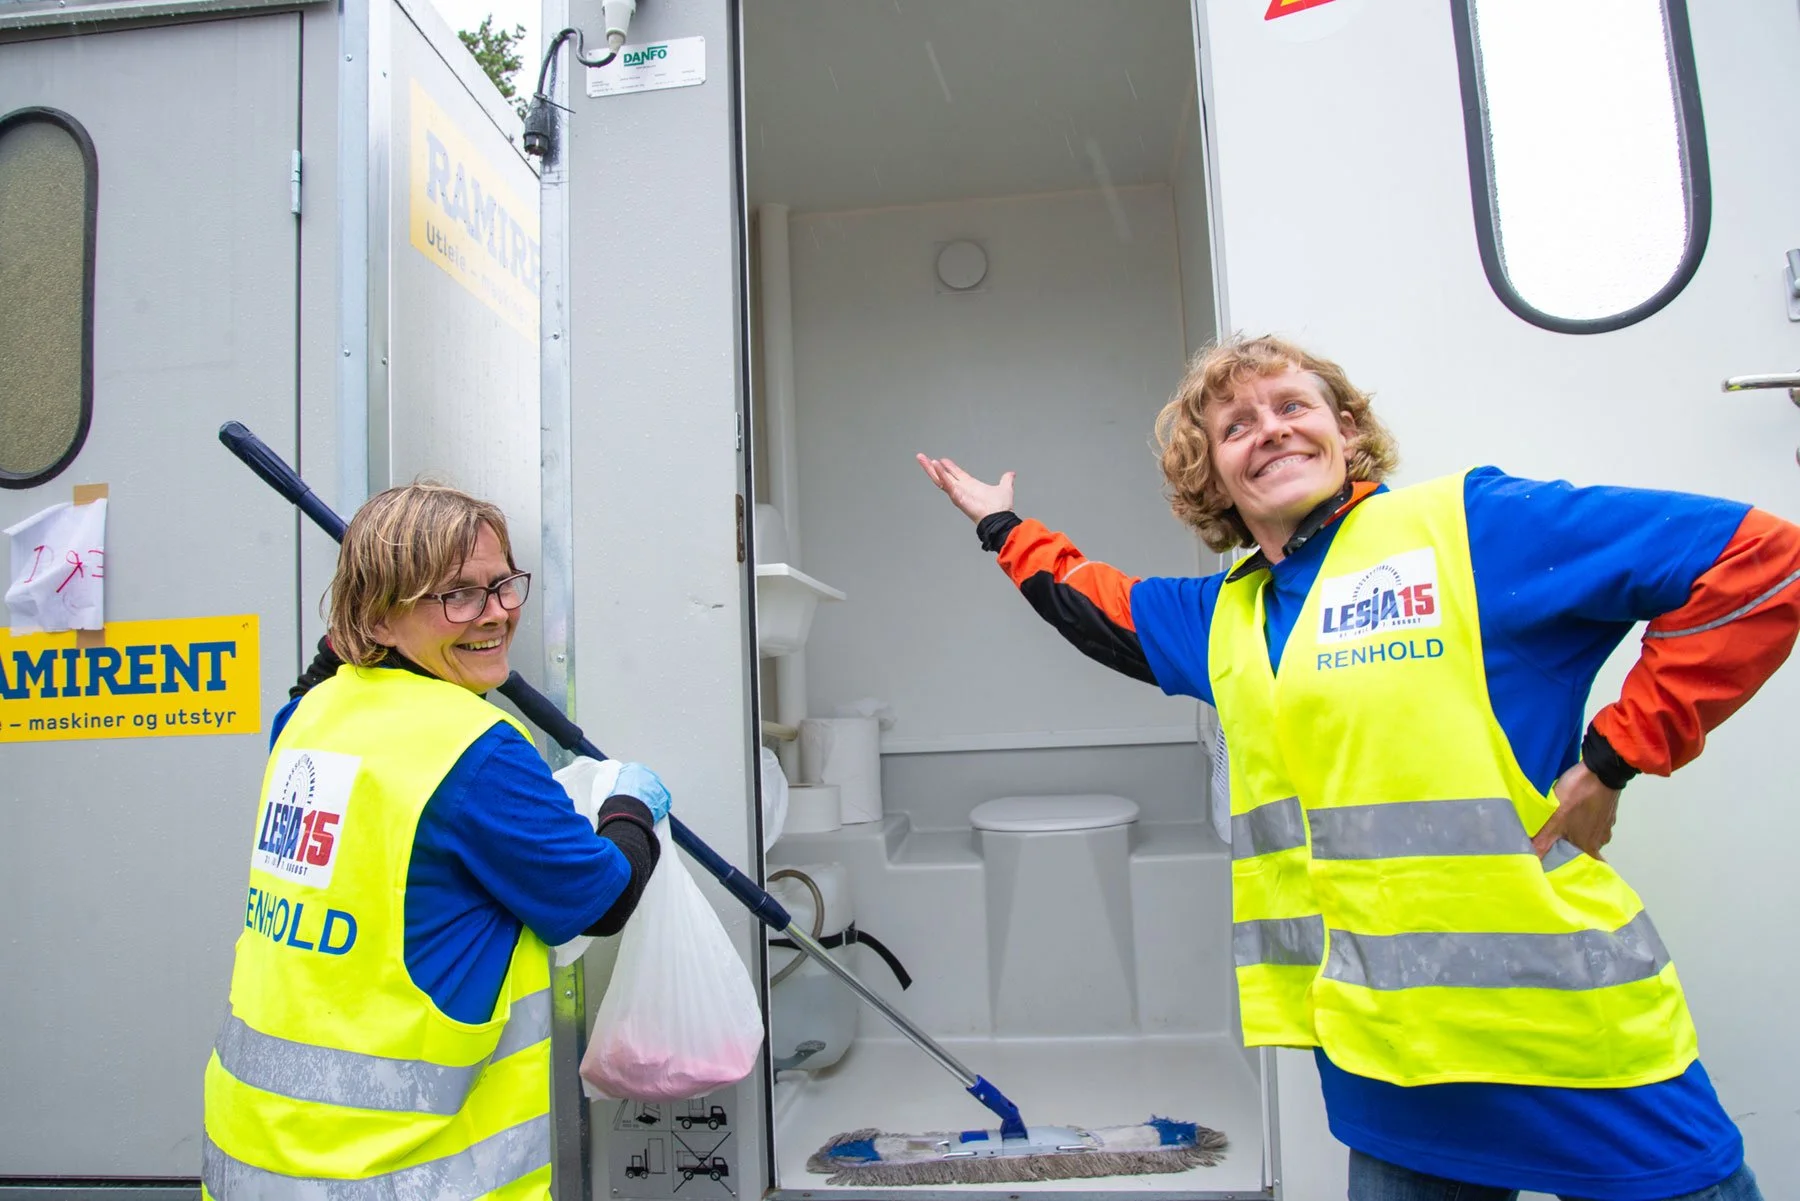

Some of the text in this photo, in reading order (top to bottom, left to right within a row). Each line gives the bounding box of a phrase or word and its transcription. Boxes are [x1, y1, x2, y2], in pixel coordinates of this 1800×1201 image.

[623, 46, 668, 66] DANFO
[1317, 638, 1444, 671] RENHOLD
[29, 713, 125, 730] maskiner
[133, 713, 157, 729] og
[165, 708, 236, 728] utstyr
